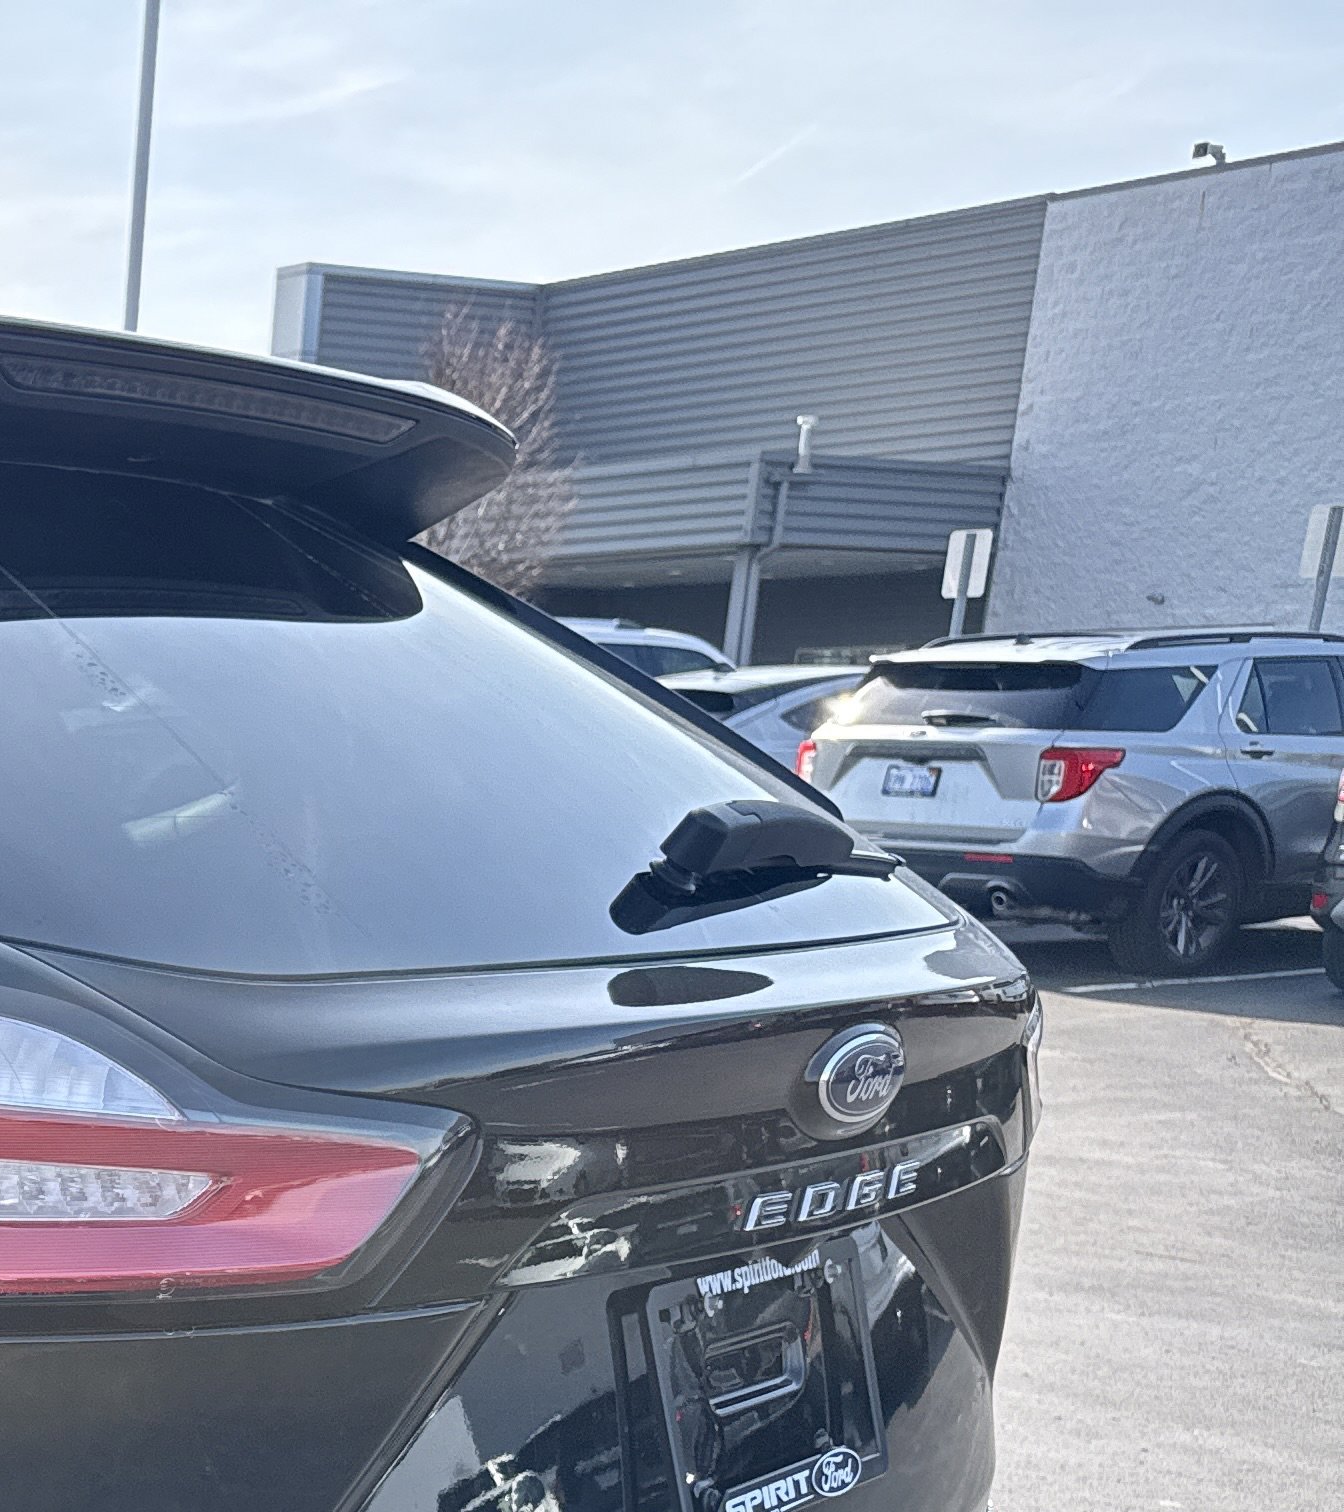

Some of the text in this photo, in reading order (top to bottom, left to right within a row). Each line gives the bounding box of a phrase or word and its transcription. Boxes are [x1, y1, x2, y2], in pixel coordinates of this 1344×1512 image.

[846, 1053, 896, 1103] Ford
[743, 1160, 921, 1231] EDGE
[821, 1454, 855, 1492] Ford
